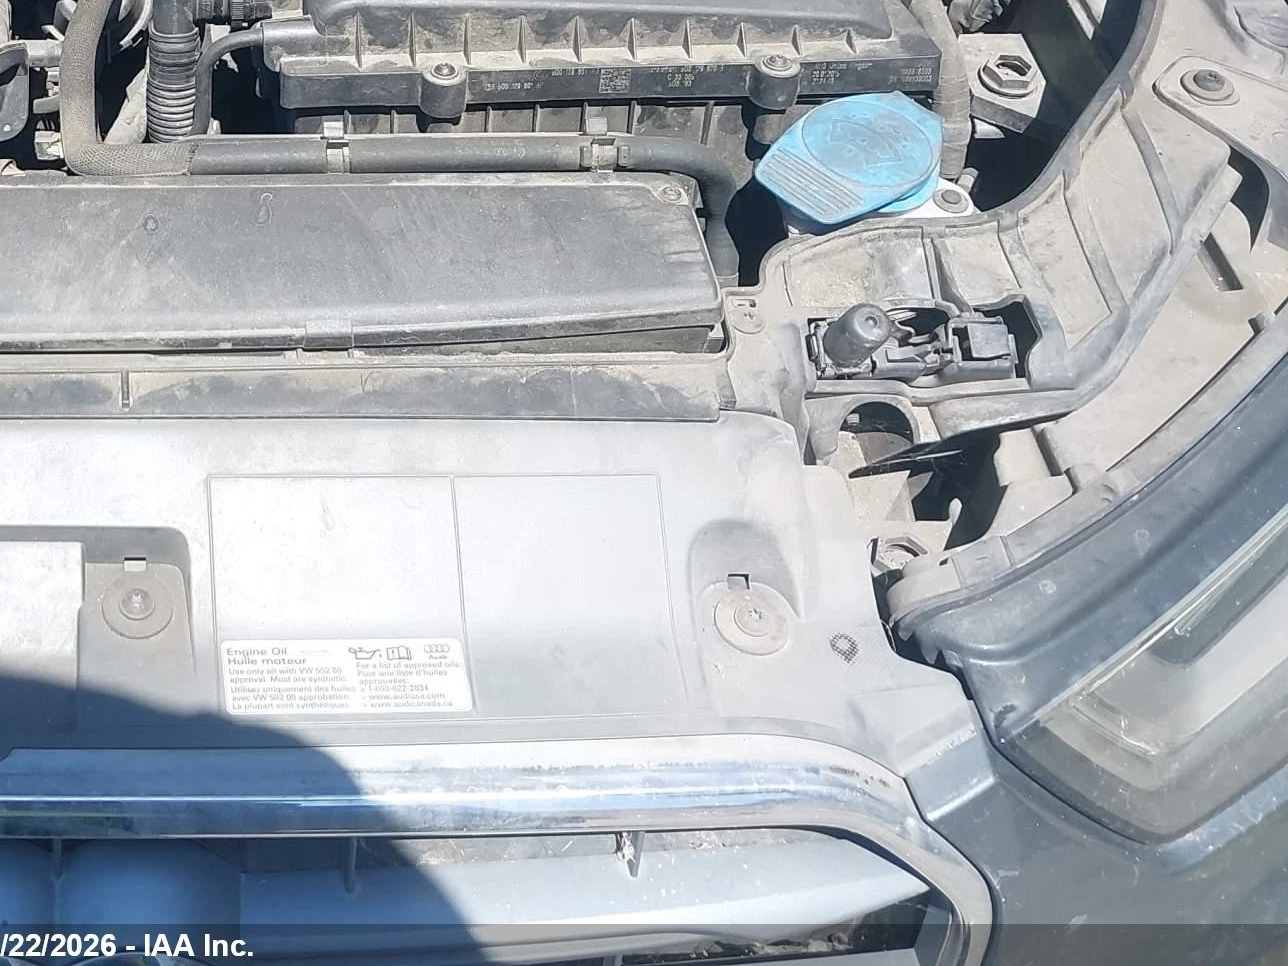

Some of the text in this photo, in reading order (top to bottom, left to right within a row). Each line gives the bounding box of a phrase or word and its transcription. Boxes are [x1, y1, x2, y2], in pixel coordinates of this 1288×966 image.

[226, 647, 287, 657] Engine Oil
[228, 657, 257, 665] Huile
[404, 661, 442, 669] approved
[247, 668, 264, 676] only
[262, 686, 312, 694] uniquement
[244, 703, 274, 711] plupart
